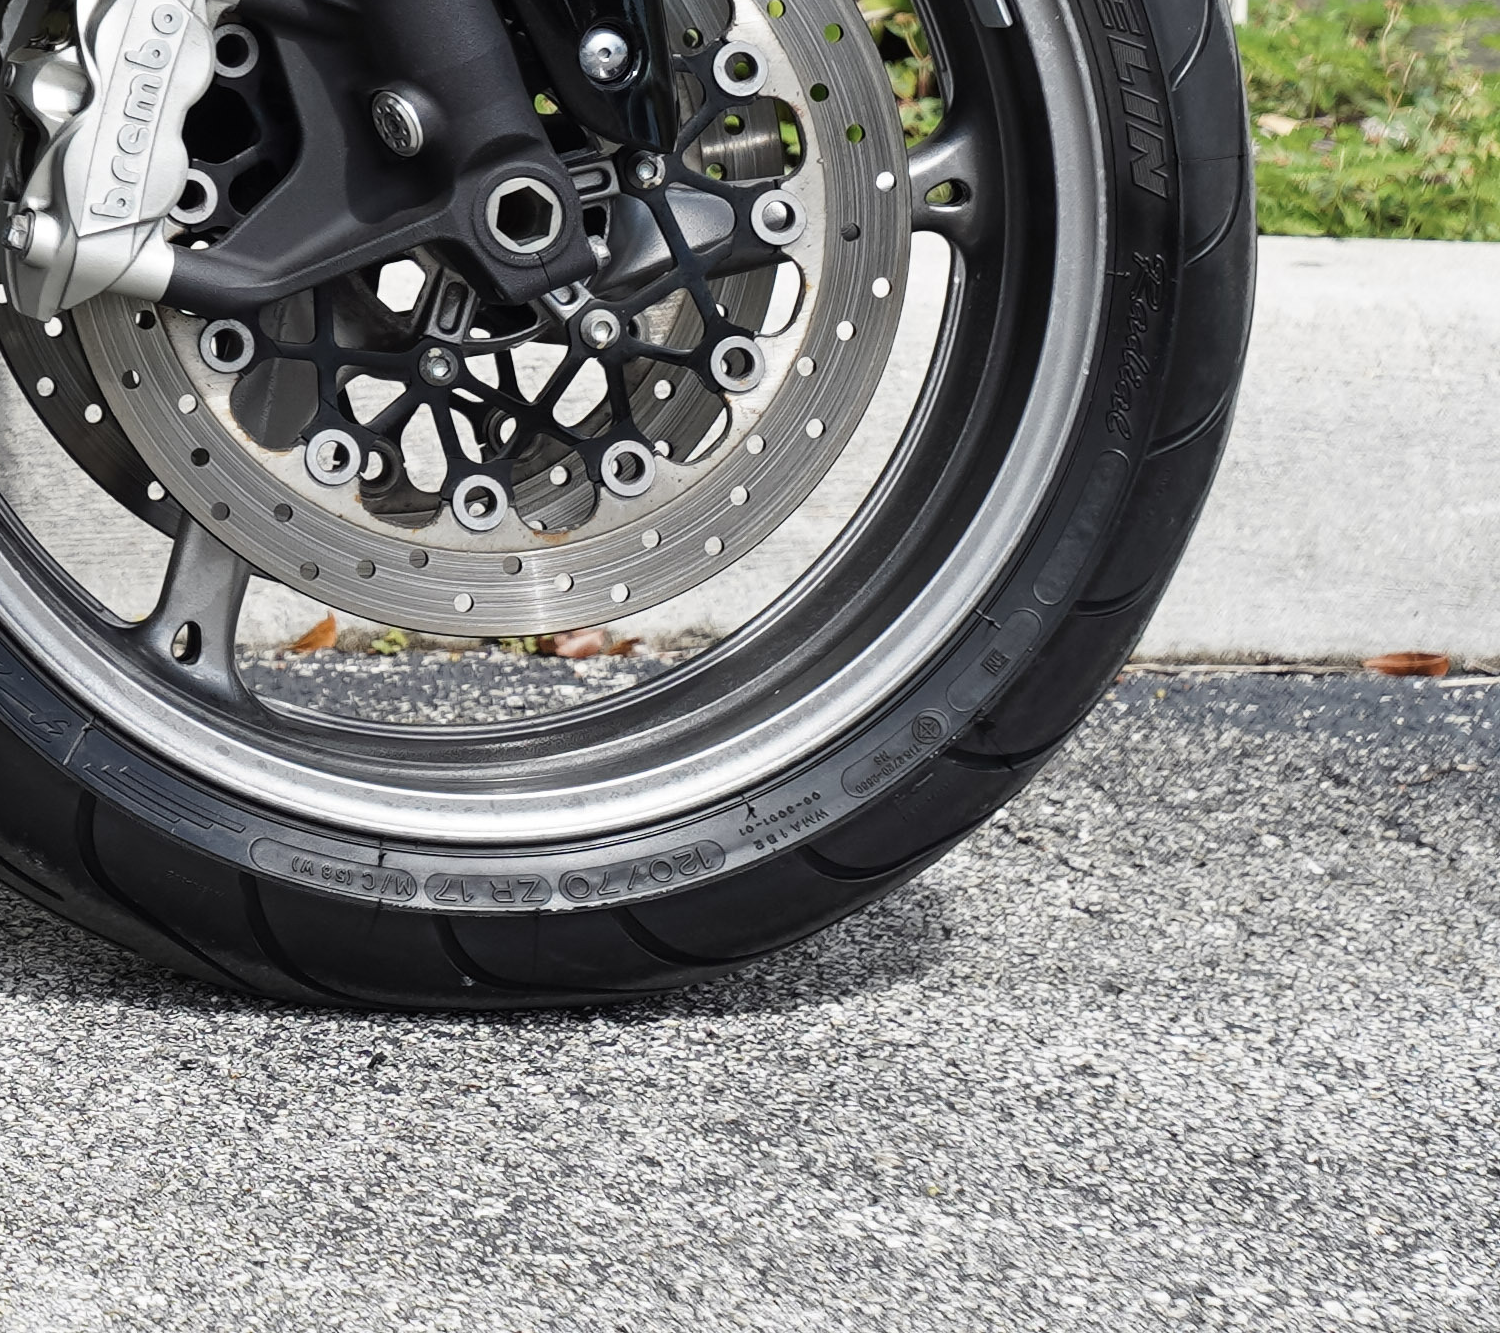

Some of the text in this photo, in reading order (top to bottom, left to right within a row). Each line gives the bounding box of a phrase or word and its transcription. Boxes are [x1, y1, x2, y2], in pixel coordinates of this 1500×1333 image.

[90, 2, 186, 220] brembo
[1096, 251, 1169, 443] Radial
[358, 869, 413, 896] M/C
[431, 875, 547, 904] ZR 17
[560, 841, 714, 902] 120/70
